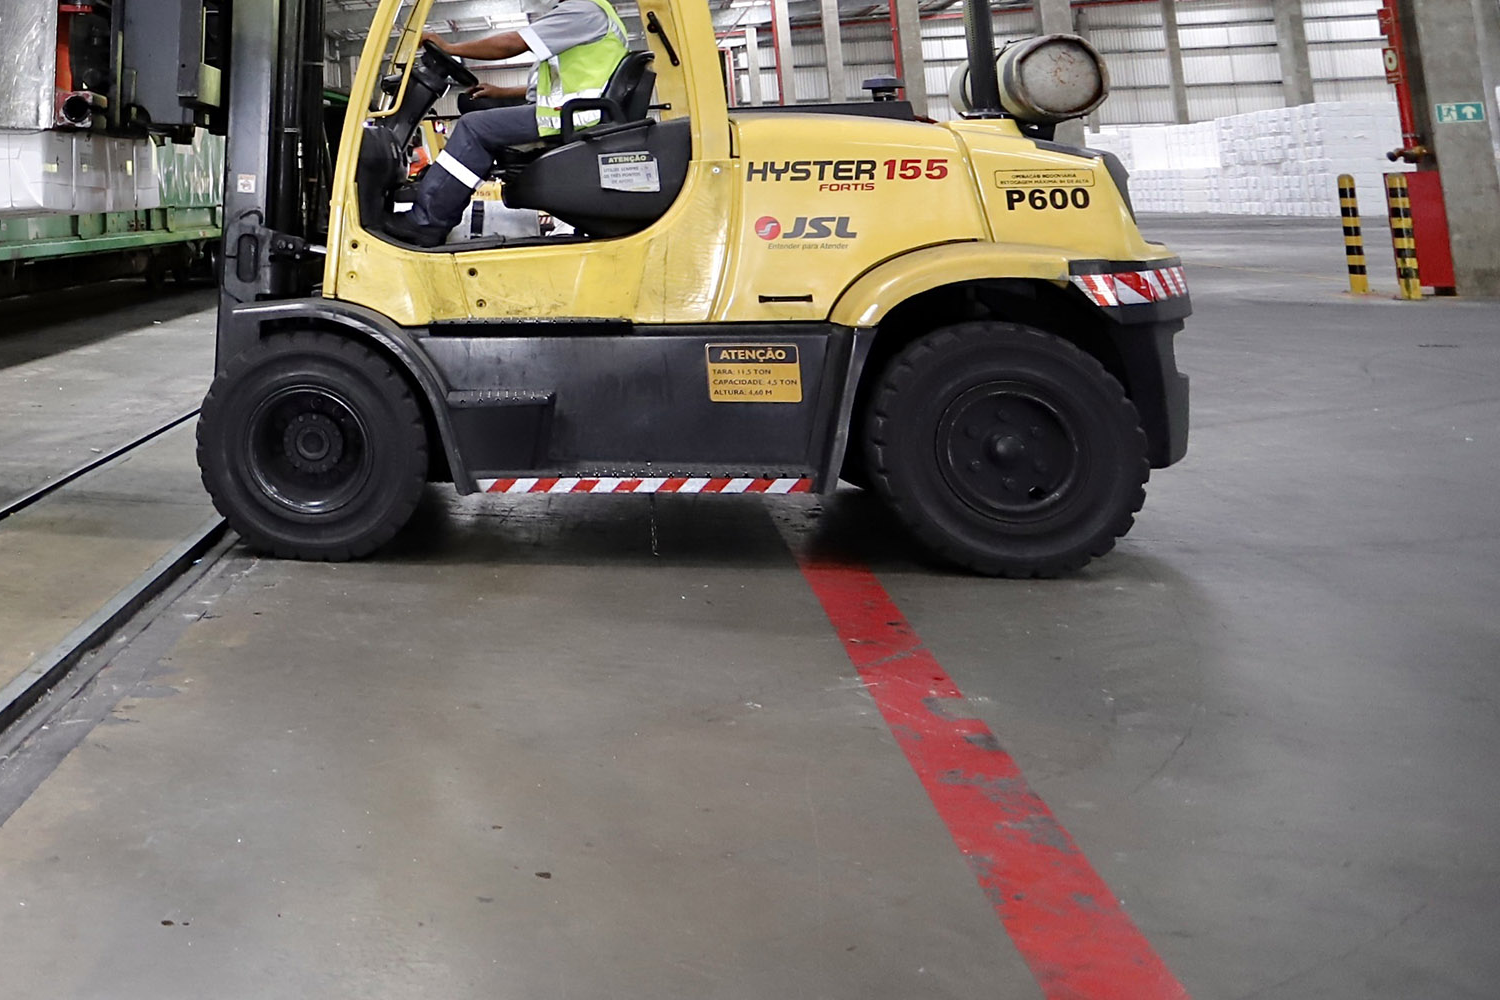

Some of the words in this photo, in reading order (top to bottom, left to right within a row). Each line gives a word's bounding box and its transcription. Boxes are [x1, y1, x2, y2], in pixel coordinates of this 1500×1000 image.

[608, 154, 647, 163] ATENÇÃO
[746, 160, 877, 182] HYSTER
[883, 159, 948, 180] 155
[819, 183, 875, 192] FORTIS
[1006, 188, 1090, 210] P600
[782, 216, 858, 239] JSL
[720, 347, 786, 362] ATENÇÃO
